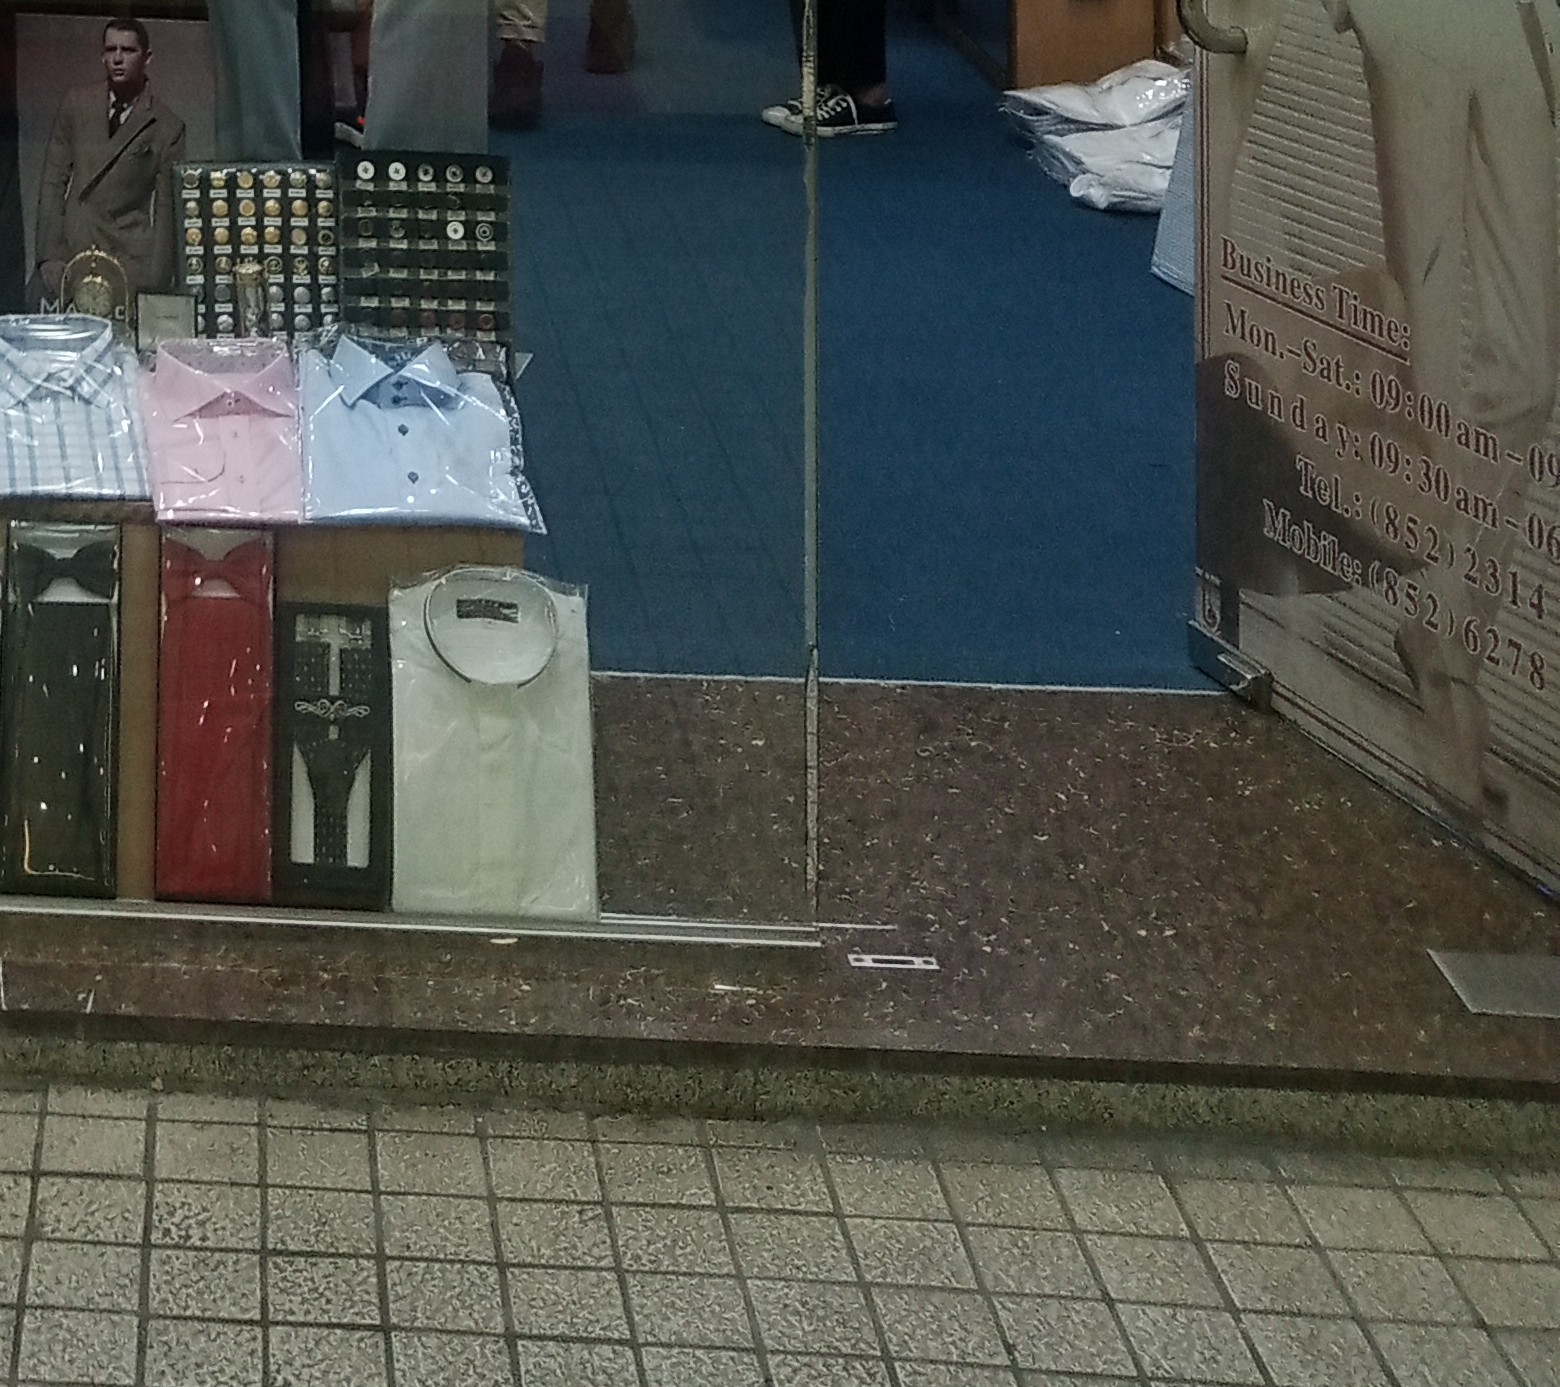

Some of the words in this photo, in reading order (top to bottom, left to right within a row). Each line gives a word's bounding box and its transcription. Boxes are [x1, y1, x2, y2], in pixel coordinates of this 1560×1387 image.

[1220, 235, 1326, 311] Business
[1331, 283, 1412, 351] Time:
[1261, 499, 1363, 586] Mobile:
[1462, 615, 1547, 693] 6278
